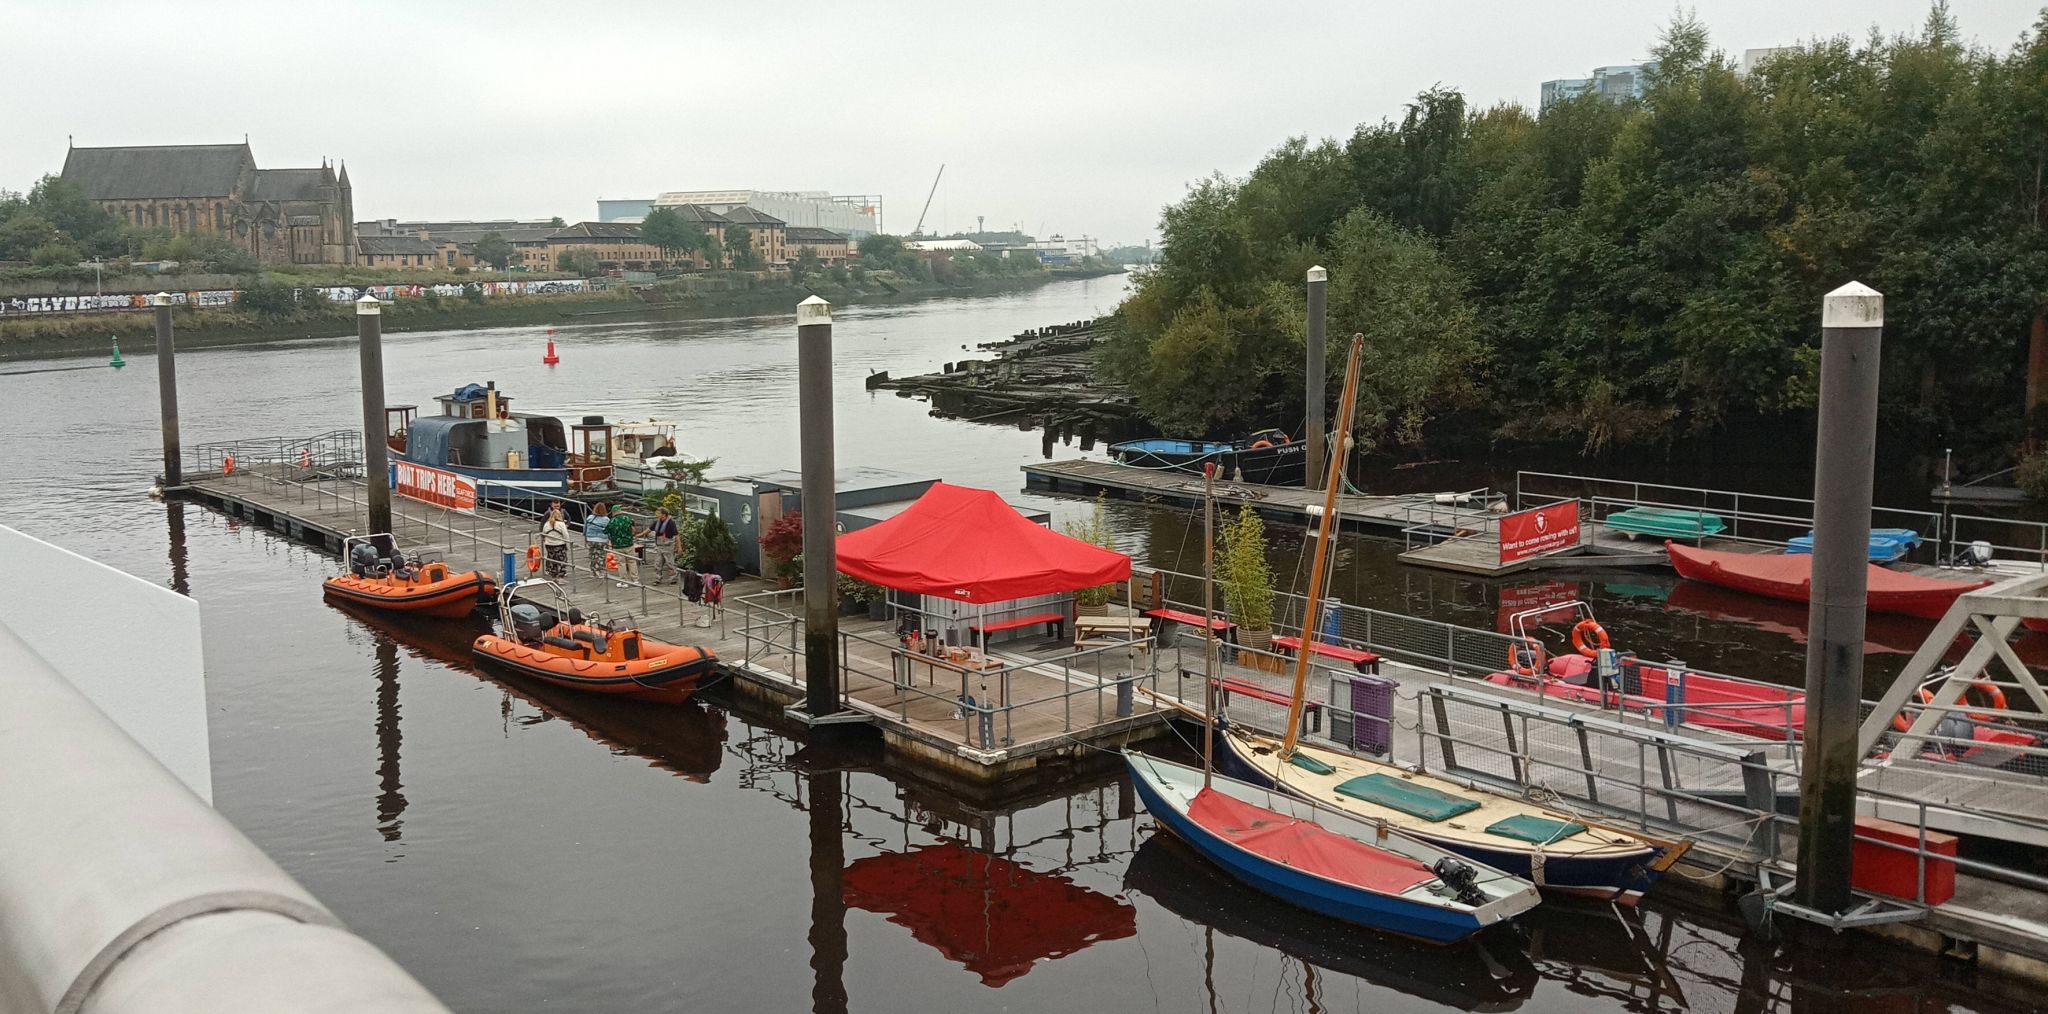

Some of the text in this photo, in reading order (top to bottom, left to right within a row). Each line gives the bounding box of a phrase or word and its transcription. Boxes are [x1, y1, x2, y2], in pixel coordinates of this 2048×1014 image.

[27, 295, 91, 311] CLYDE
[1277, 446, 1299, 454] PUSH
[398, 464, 456, 498] BOAT TRIPS HERE
[1502, 541, 1518, 550] Want
[1526, 538, 1540, 546] come
[1540, 532, 1557, 541] rowing
[1558, 530, 1568, 538] with
